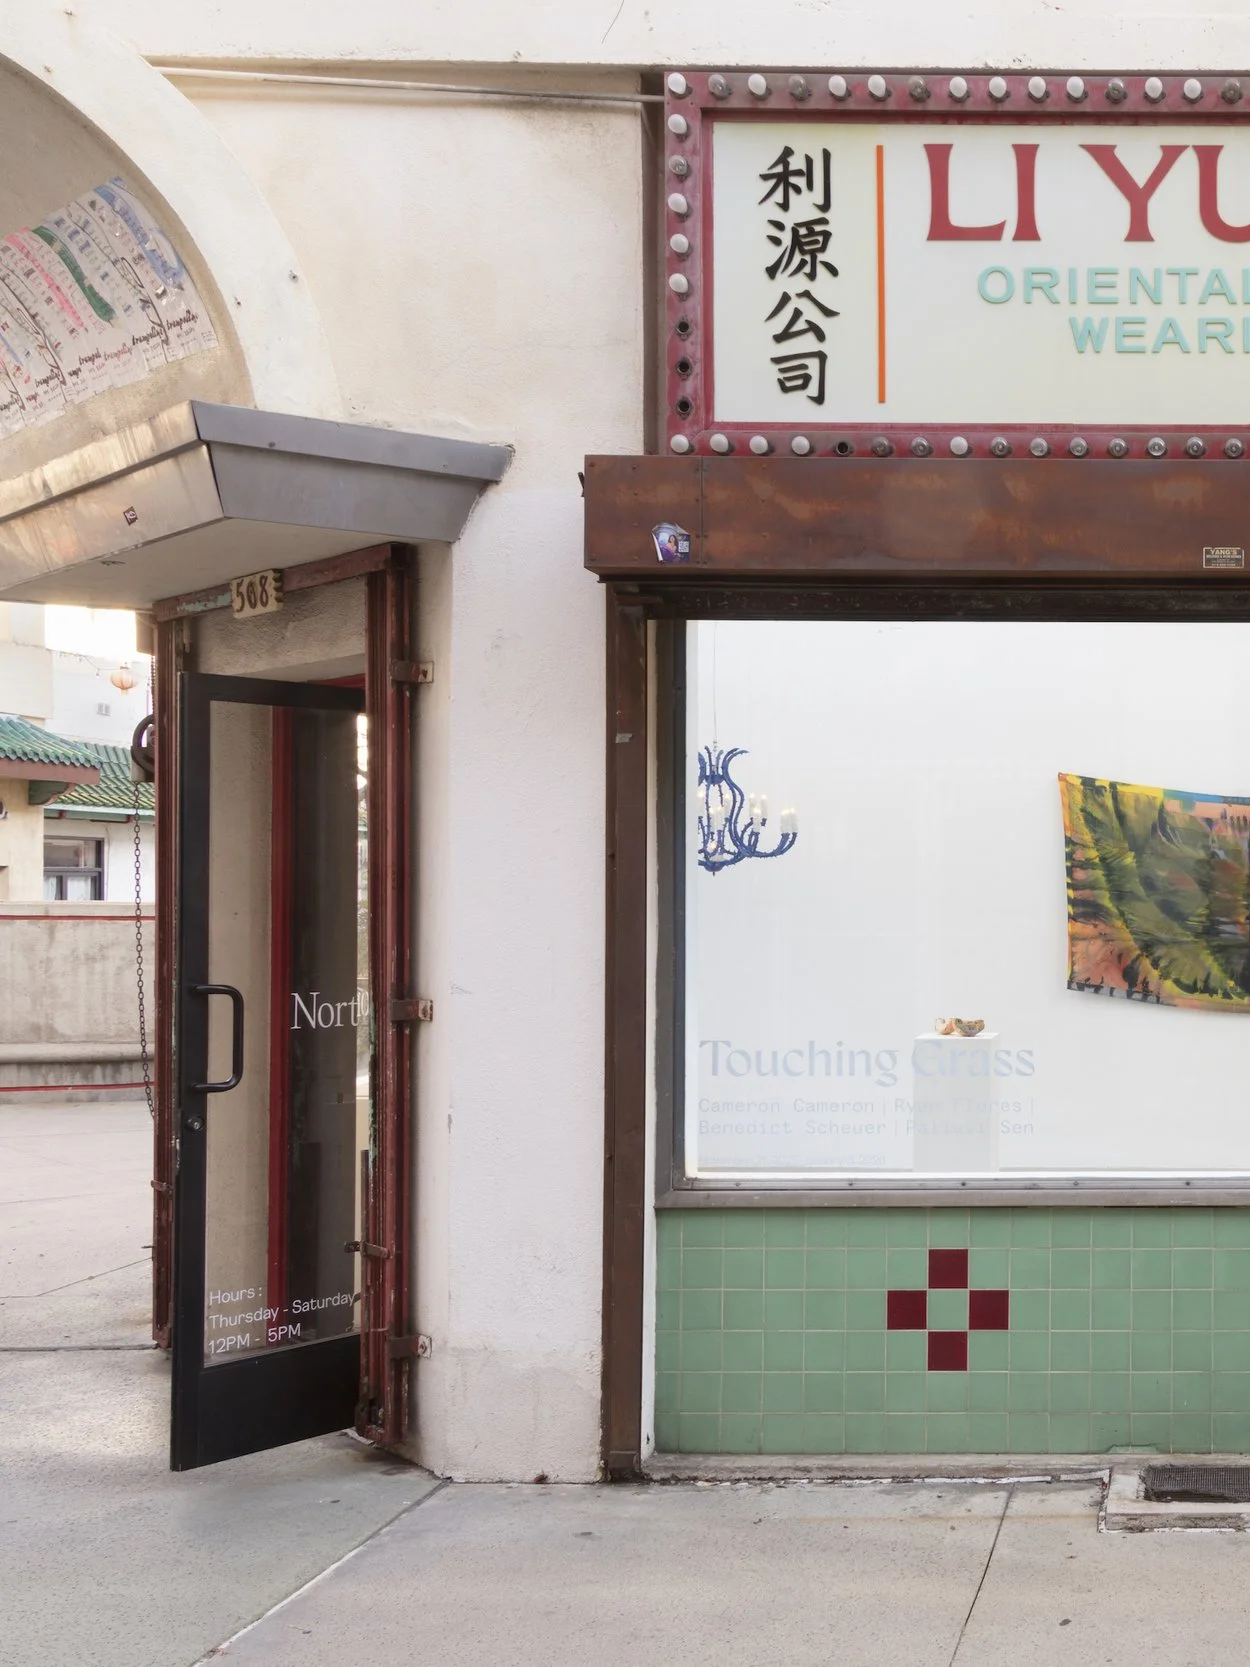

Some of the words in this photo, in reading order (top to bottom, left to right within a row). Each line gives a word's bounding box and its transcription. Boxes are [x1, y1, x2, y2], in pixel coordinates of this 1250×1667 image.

[923, 143, 1041, 242] LI
[758, 145, 840, 406] 利源公司
[236, 575, 269, 612] 508
[699, 1040, 899, 1087] Touching
[911, 1040, 1035, 1078] Grass
[698, 1098, 780, 1113] Cameron
[793, 1098, 875, 1113] Cameron
[699, 1120, 793, 1135] Benedict
[805, 1120, 886, 1135] Scheuer
[1000, 1119, 1034, 1135] Sen
[209, 1306, 279, 1329] Thursday
[292, 1292, 356, 1314] Saturday
[209, 1333, 250, 1354] 12PM
[268, 1323, 301, 1342] 5PM
